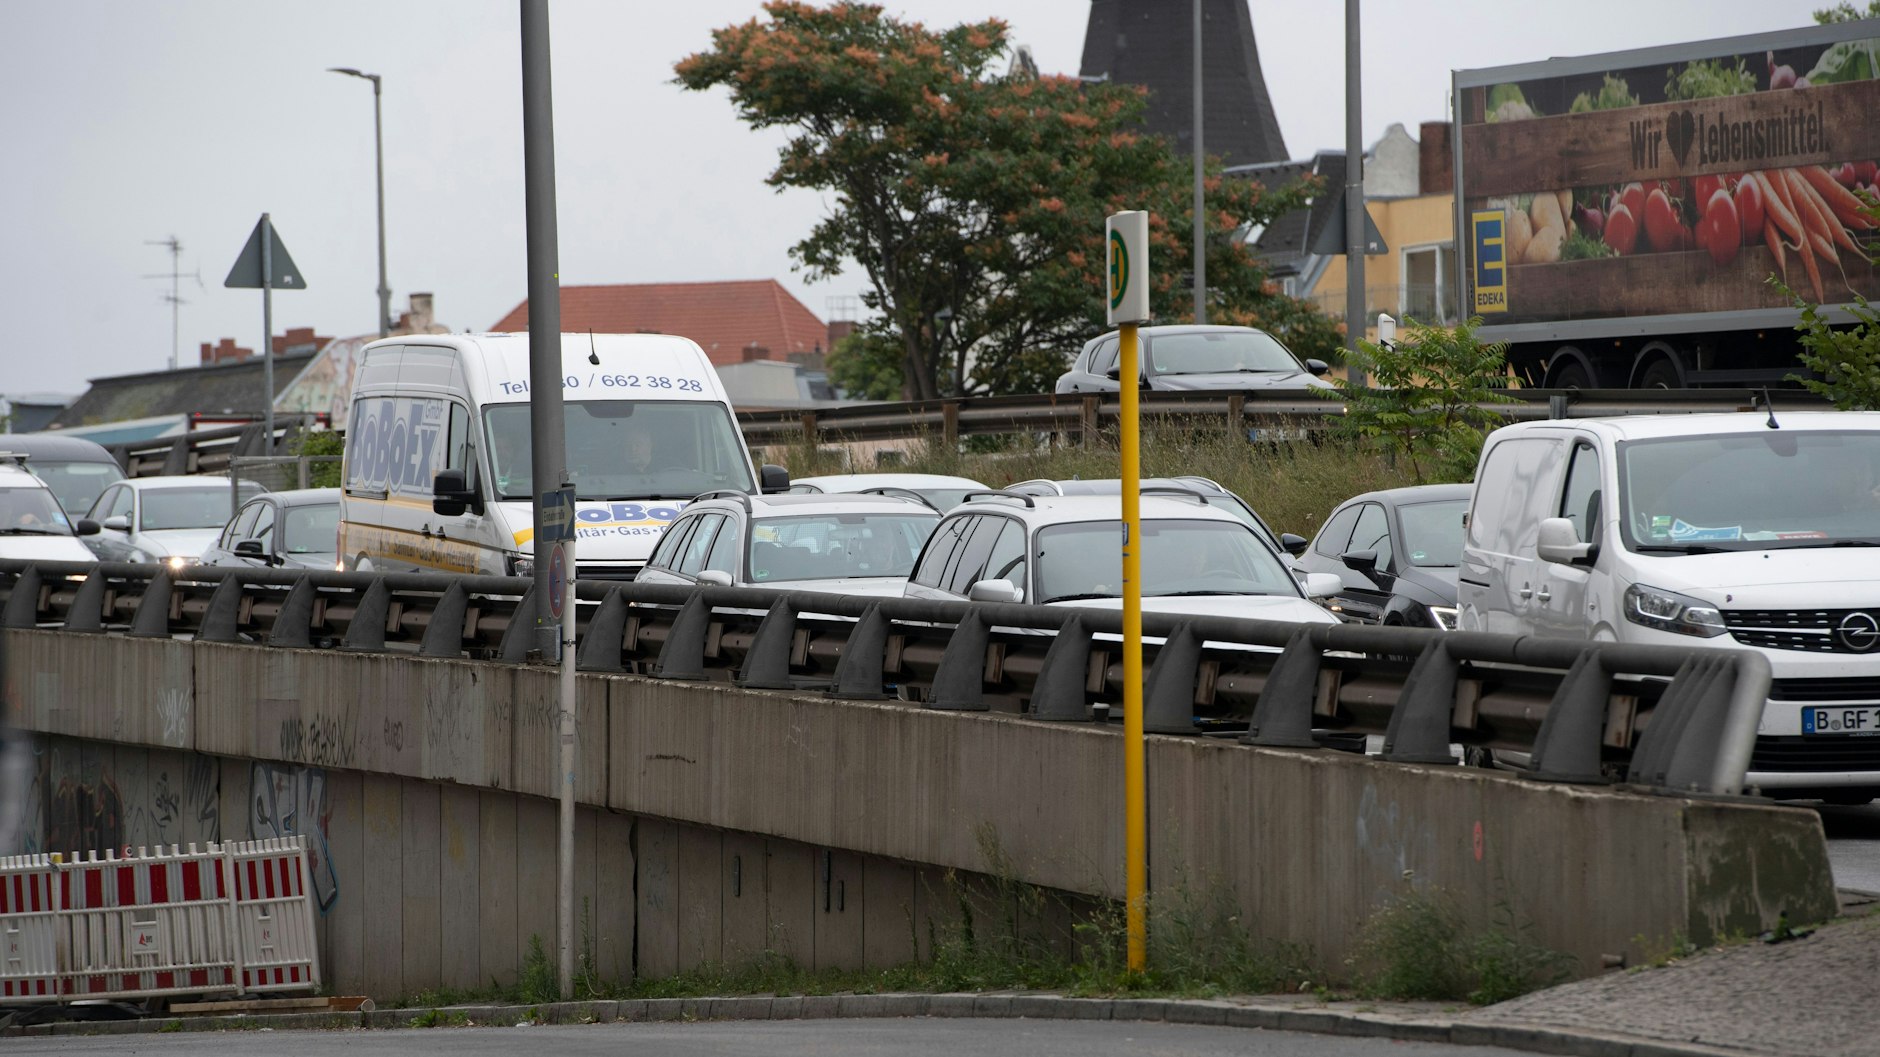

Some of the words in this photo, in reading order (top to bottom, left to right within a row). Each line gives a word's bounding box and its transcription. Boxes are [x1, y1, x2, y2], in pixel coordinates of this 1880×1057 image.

[1630, 120, 1661, 171] Wir
[1477, 292, 1505, 306] EDEKA
[601, 374, 641, 388] 662
[647, 376, 672, 389] 38
[677, 378, 703, 393] 28
[617, 526, 651, 536] Gas
[1816, 711, 1829, 730] B
[1843, 710, 1869, 729] GF
